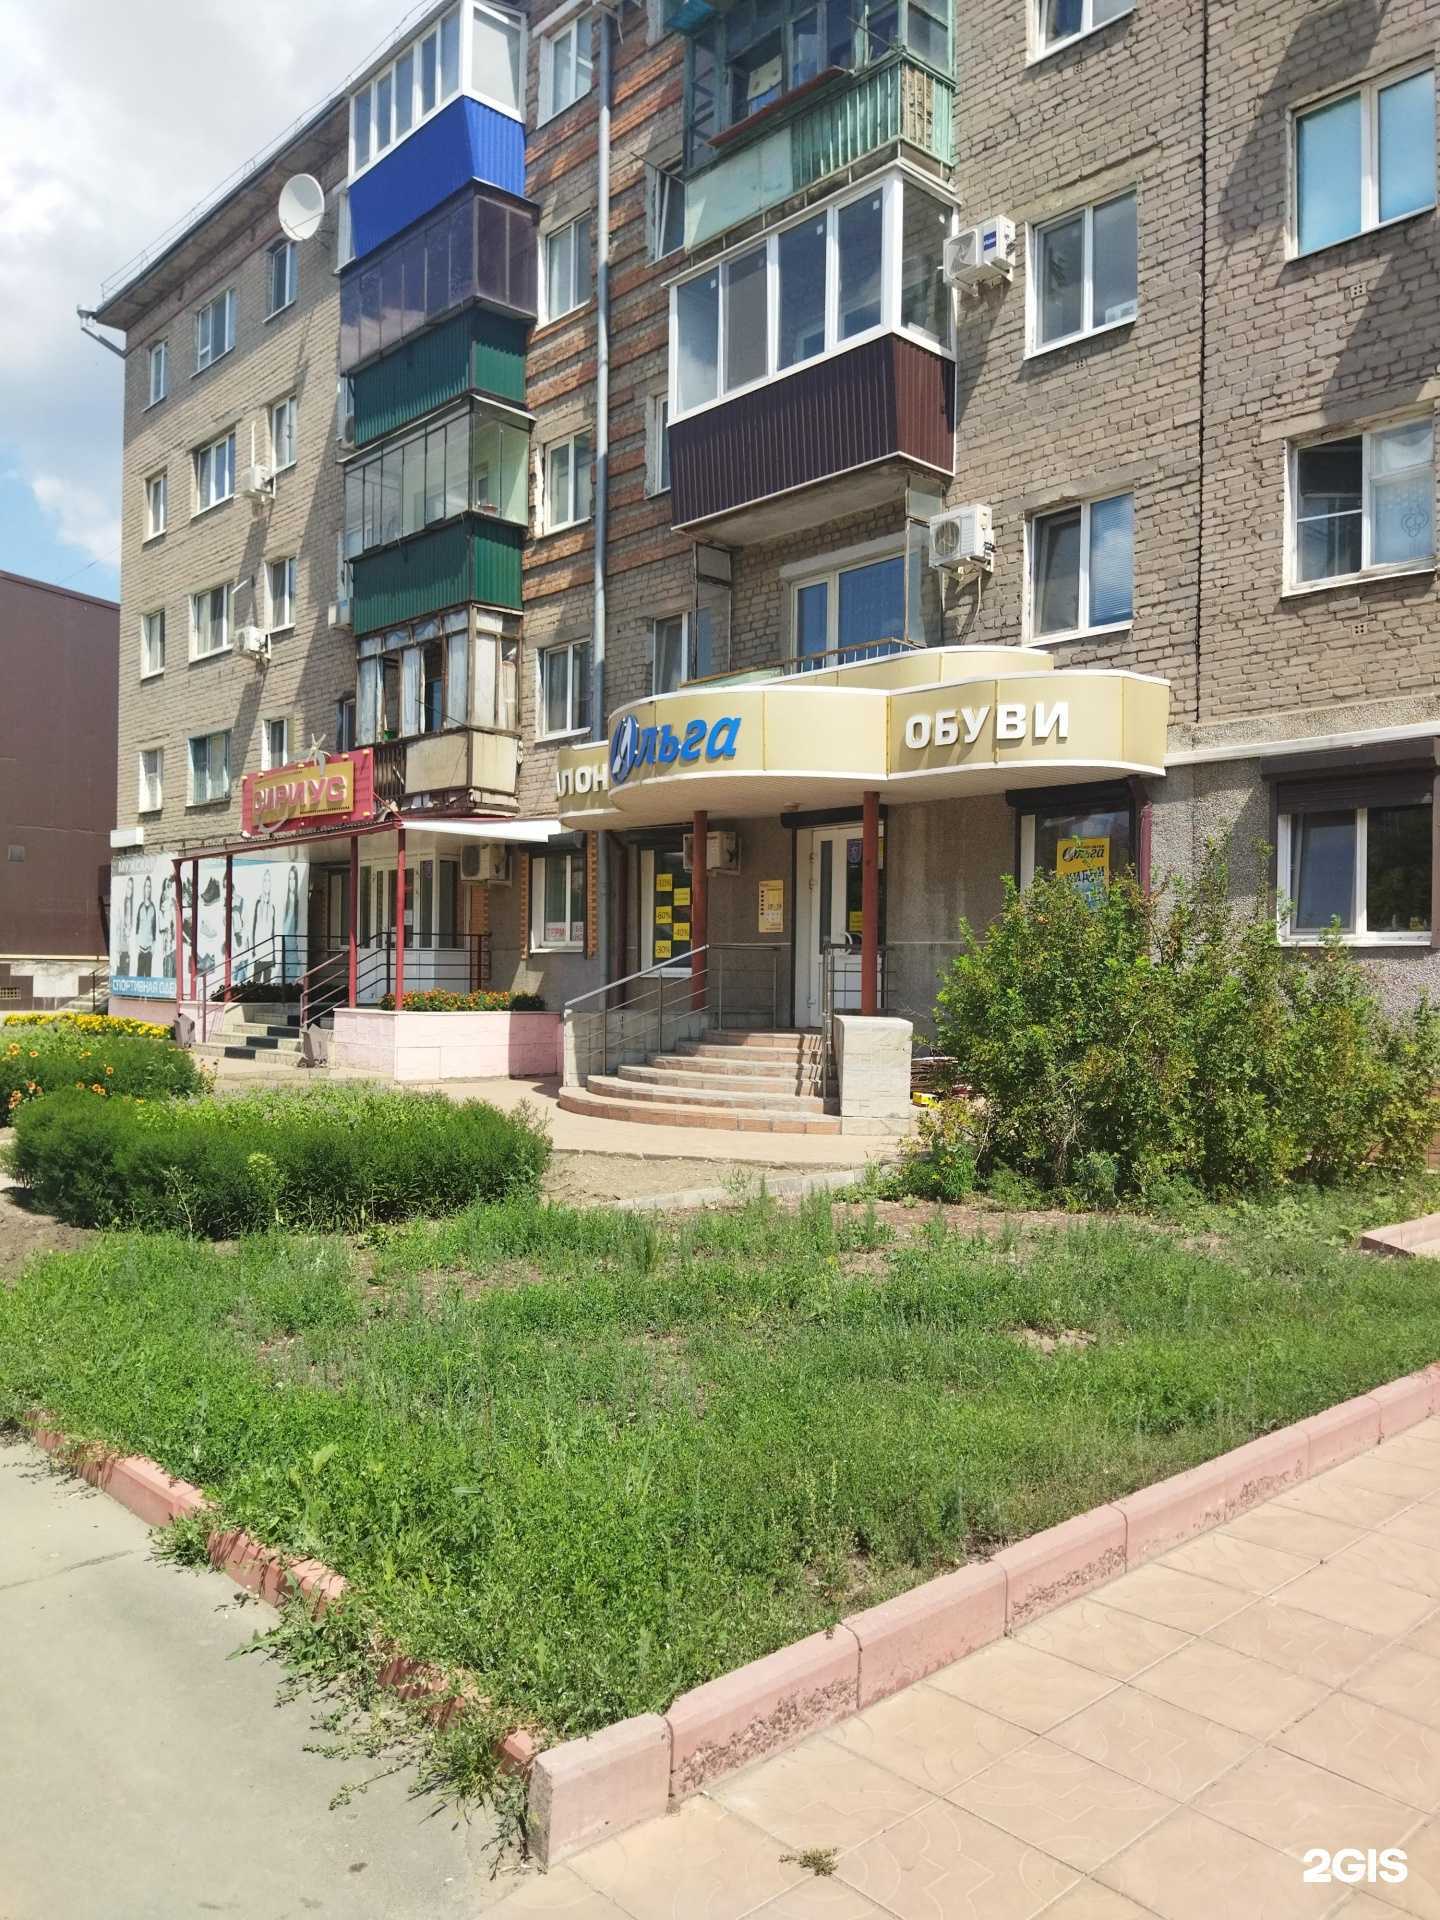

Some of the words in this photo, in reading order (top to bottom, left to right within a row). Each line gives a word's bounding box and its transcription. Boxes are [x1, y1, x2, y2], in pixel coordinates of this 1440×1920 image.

[557, 763, 609, 797] ЛОН
[611, 714, 742, 785] Ольга
[905, 701, 1069, 749] ОБУВИ
[254, 775, 347, 812] СИРИУС
